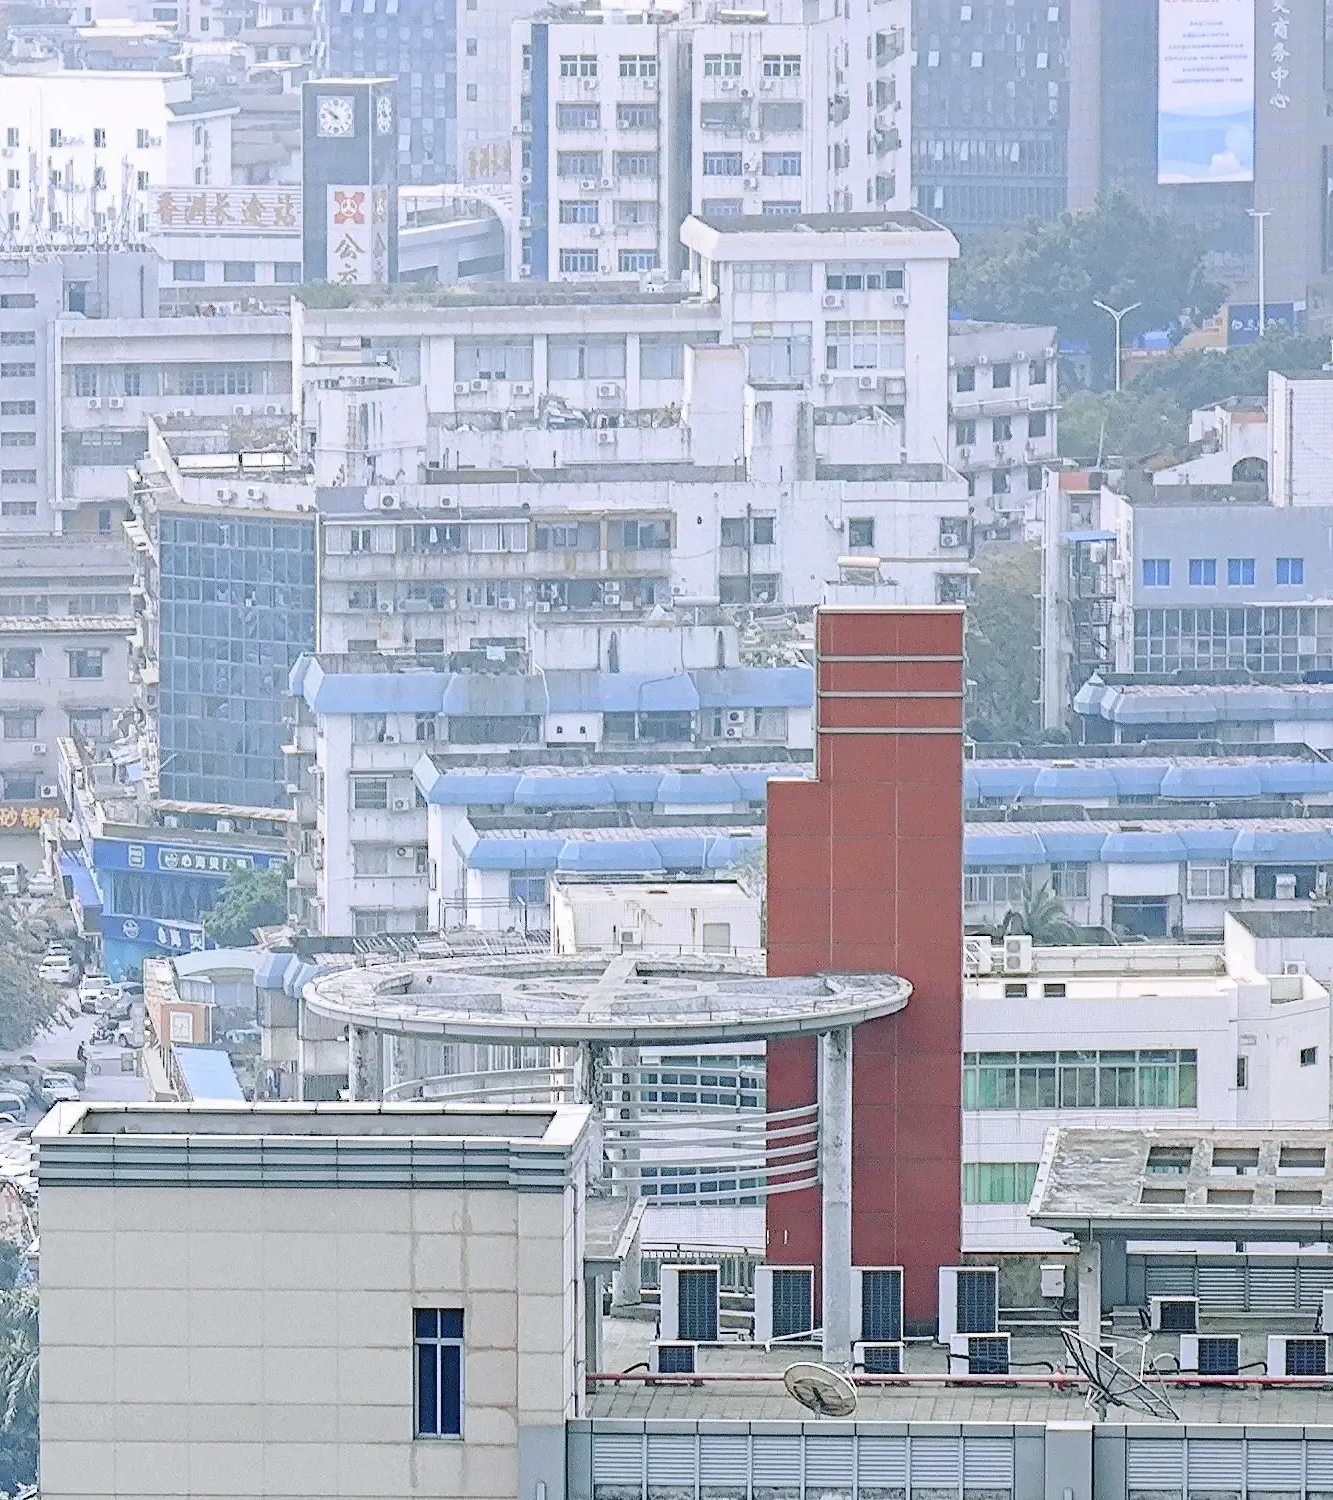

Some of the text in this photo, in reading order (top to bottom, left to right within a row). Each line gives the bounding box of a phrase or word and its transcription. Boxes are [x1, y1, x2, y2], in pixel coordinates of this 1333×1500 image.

[157, 191, 298, 227] 香洲长途站
